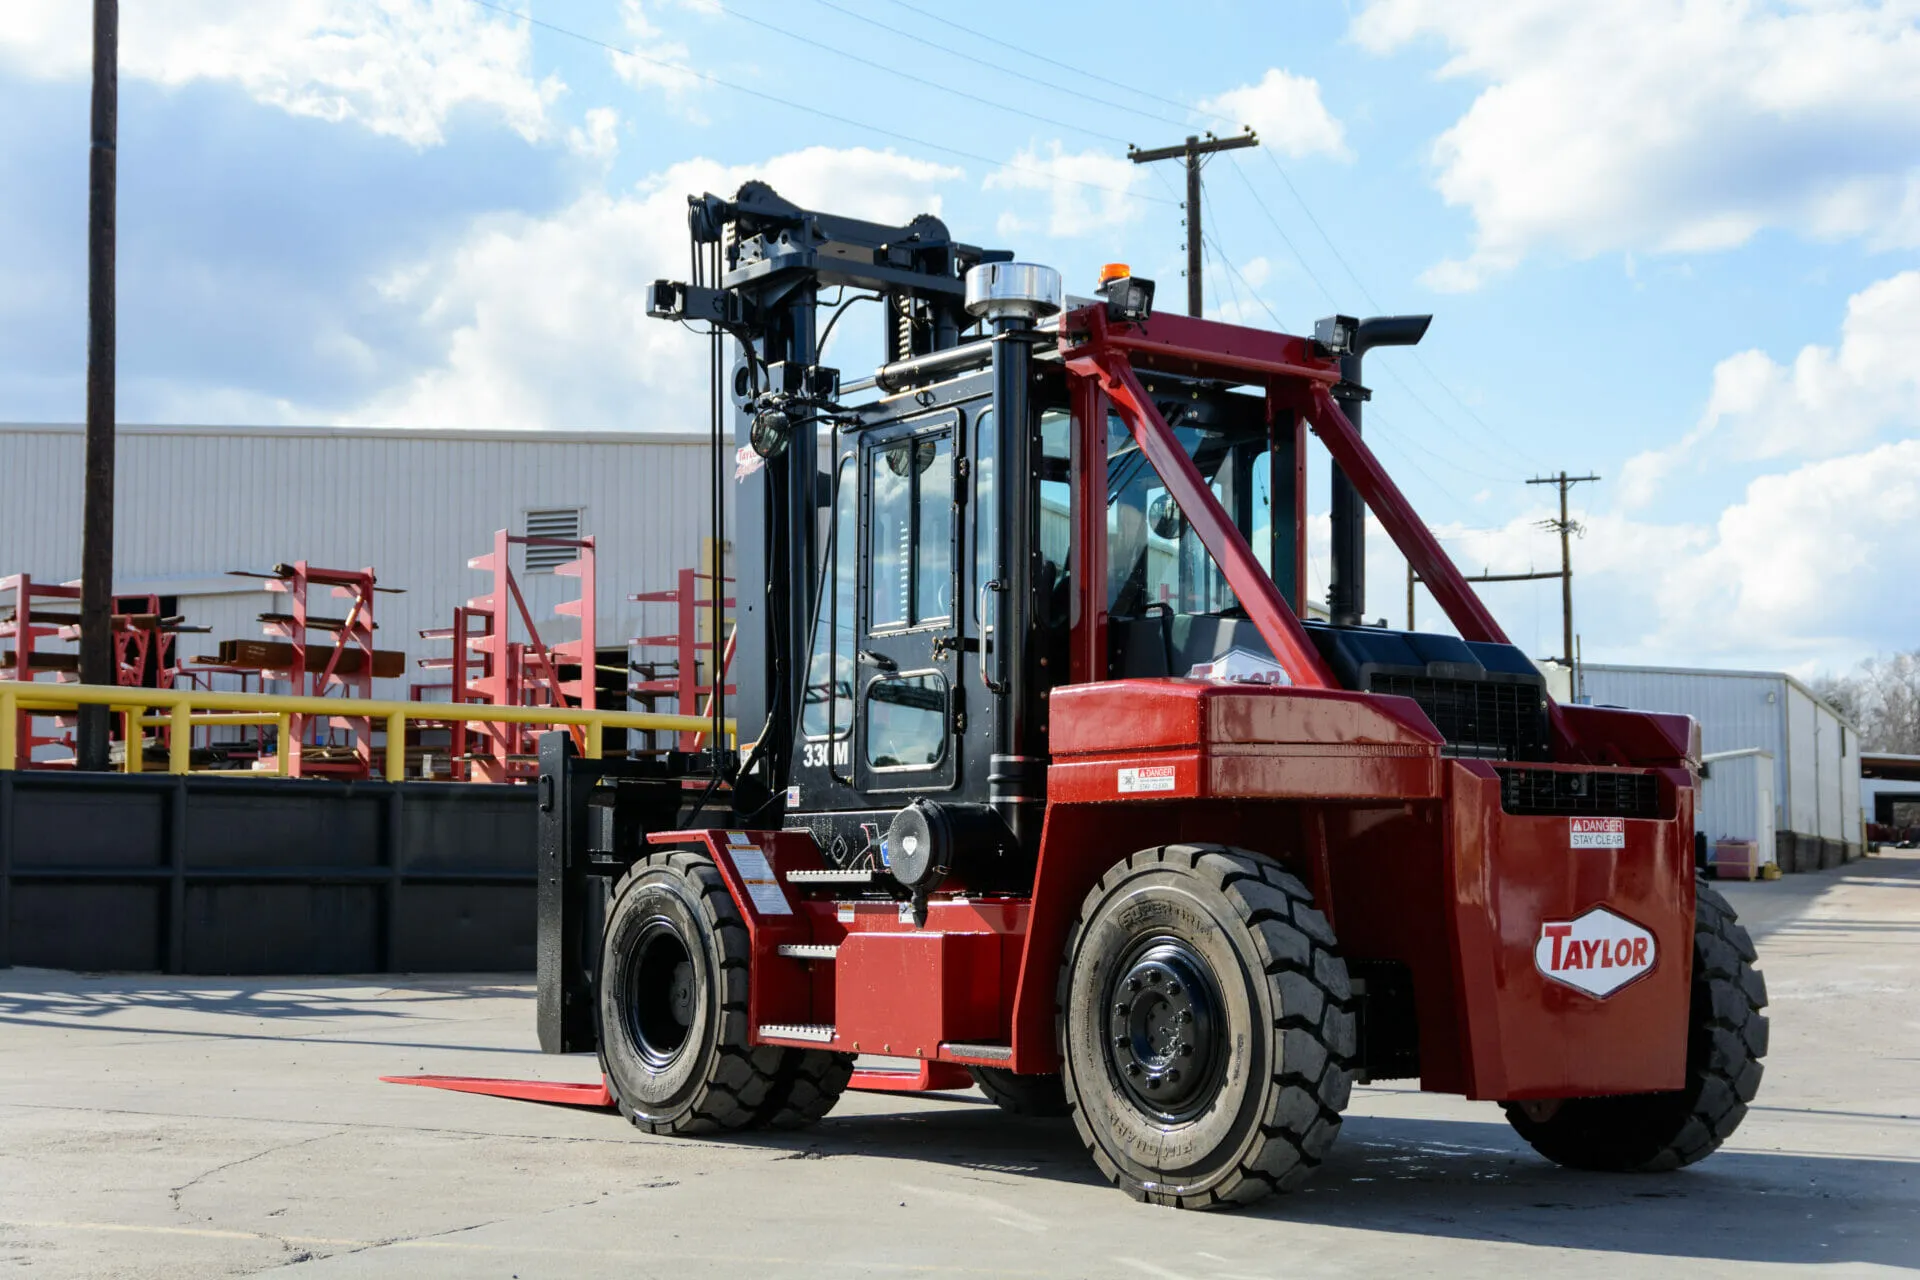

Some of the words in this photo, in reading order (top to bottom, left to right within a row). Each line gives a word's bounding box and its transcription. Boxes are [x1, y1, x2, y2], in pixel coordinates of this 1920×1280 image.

[1146, 767, 1173, 778] DANGER
[1582, 819, 1622, 832] DANGER
[1573, 834, 1593, 845] STAY
[1595, 834, 1623, 846] CLEAR
[1545, 925, 1648, 971] TAYLOR
